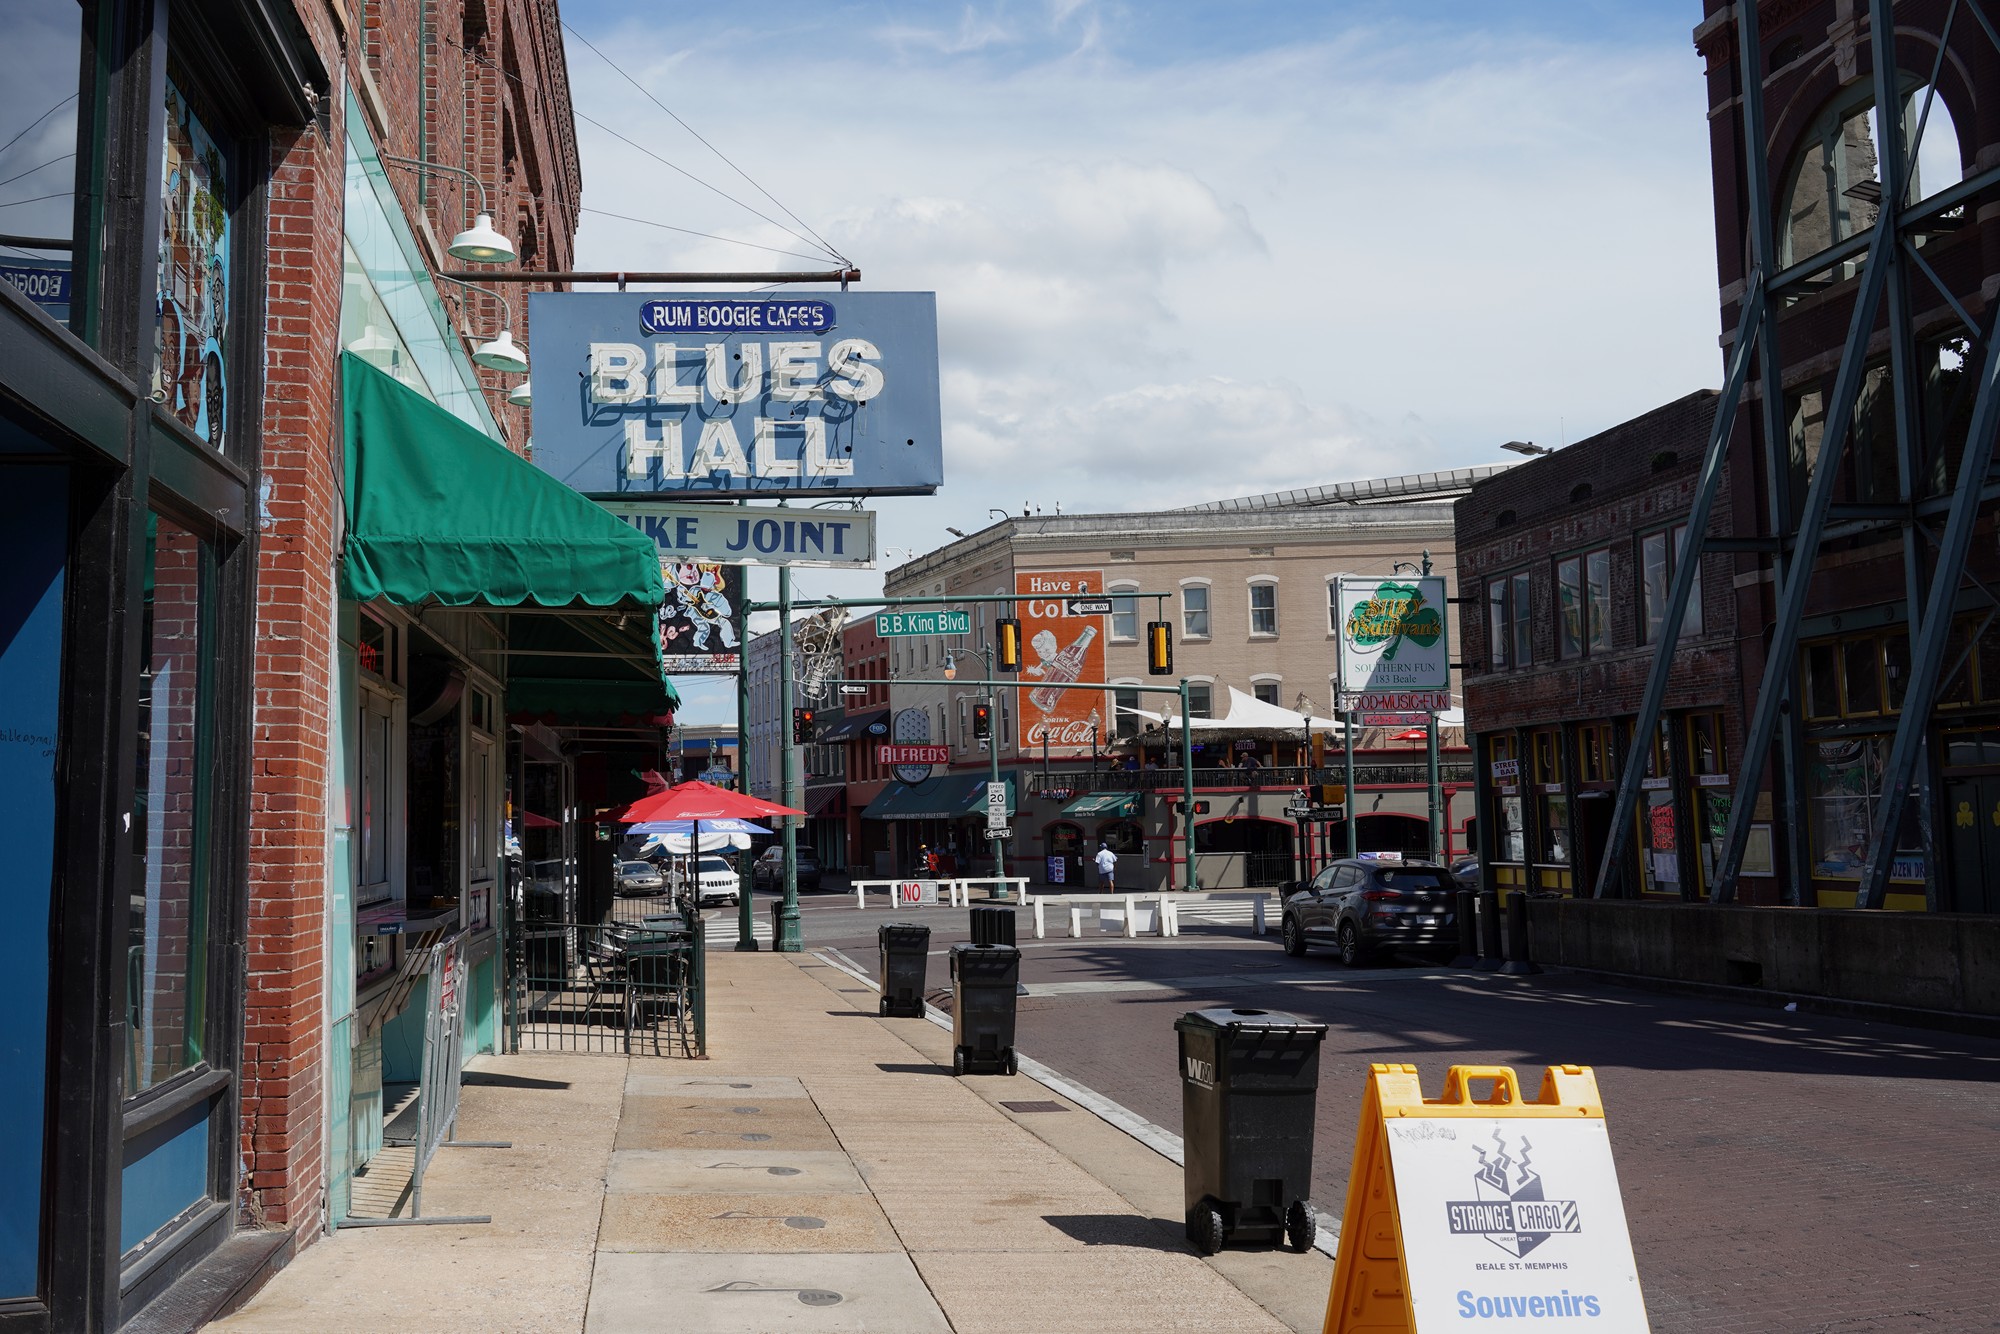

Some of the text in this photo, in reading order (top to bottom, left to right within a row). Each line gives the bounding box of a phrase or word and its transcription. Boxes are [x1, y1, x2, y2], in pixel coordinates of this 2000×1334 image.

[653, 306, 825, 327] RUM BOOGIE CAFE'S
[589, 338, 885, 405] BLUES
[624, 416, 855, 481] HALL
[726, 519, 851, 555] JOINT
[1030, 577, 1088, 593] Have a
[1366, 598, 1427, 618] SILKY
[880, 613, 968, 633] B.B. King Blvd.
[1354, 662, 1436, 673] SOUTHERN FUN
[1375, 674, 1417, 684] 183 Beale
[881, 746, 947, 763] ALFRED'S
[1494, 760, 1519, 770] STREET
[1500, 768, 1516, 776] BAR
[990, 793, 1004, 803] 20
[1653, 837, 1674, 849] RIBS
[1891, 862, 1925, 878] OZEN DR
[903, 883, 921, 902] NO
[1187, 1056, 1214, 1085] WM
[1450, 1204, 1562, 1231] STRANGE CARGO
[1475, 1262, 1568, 1270] BEALE ST. MEMPHIS
[1456, 1289, 1601, 1319] Souvenirs
